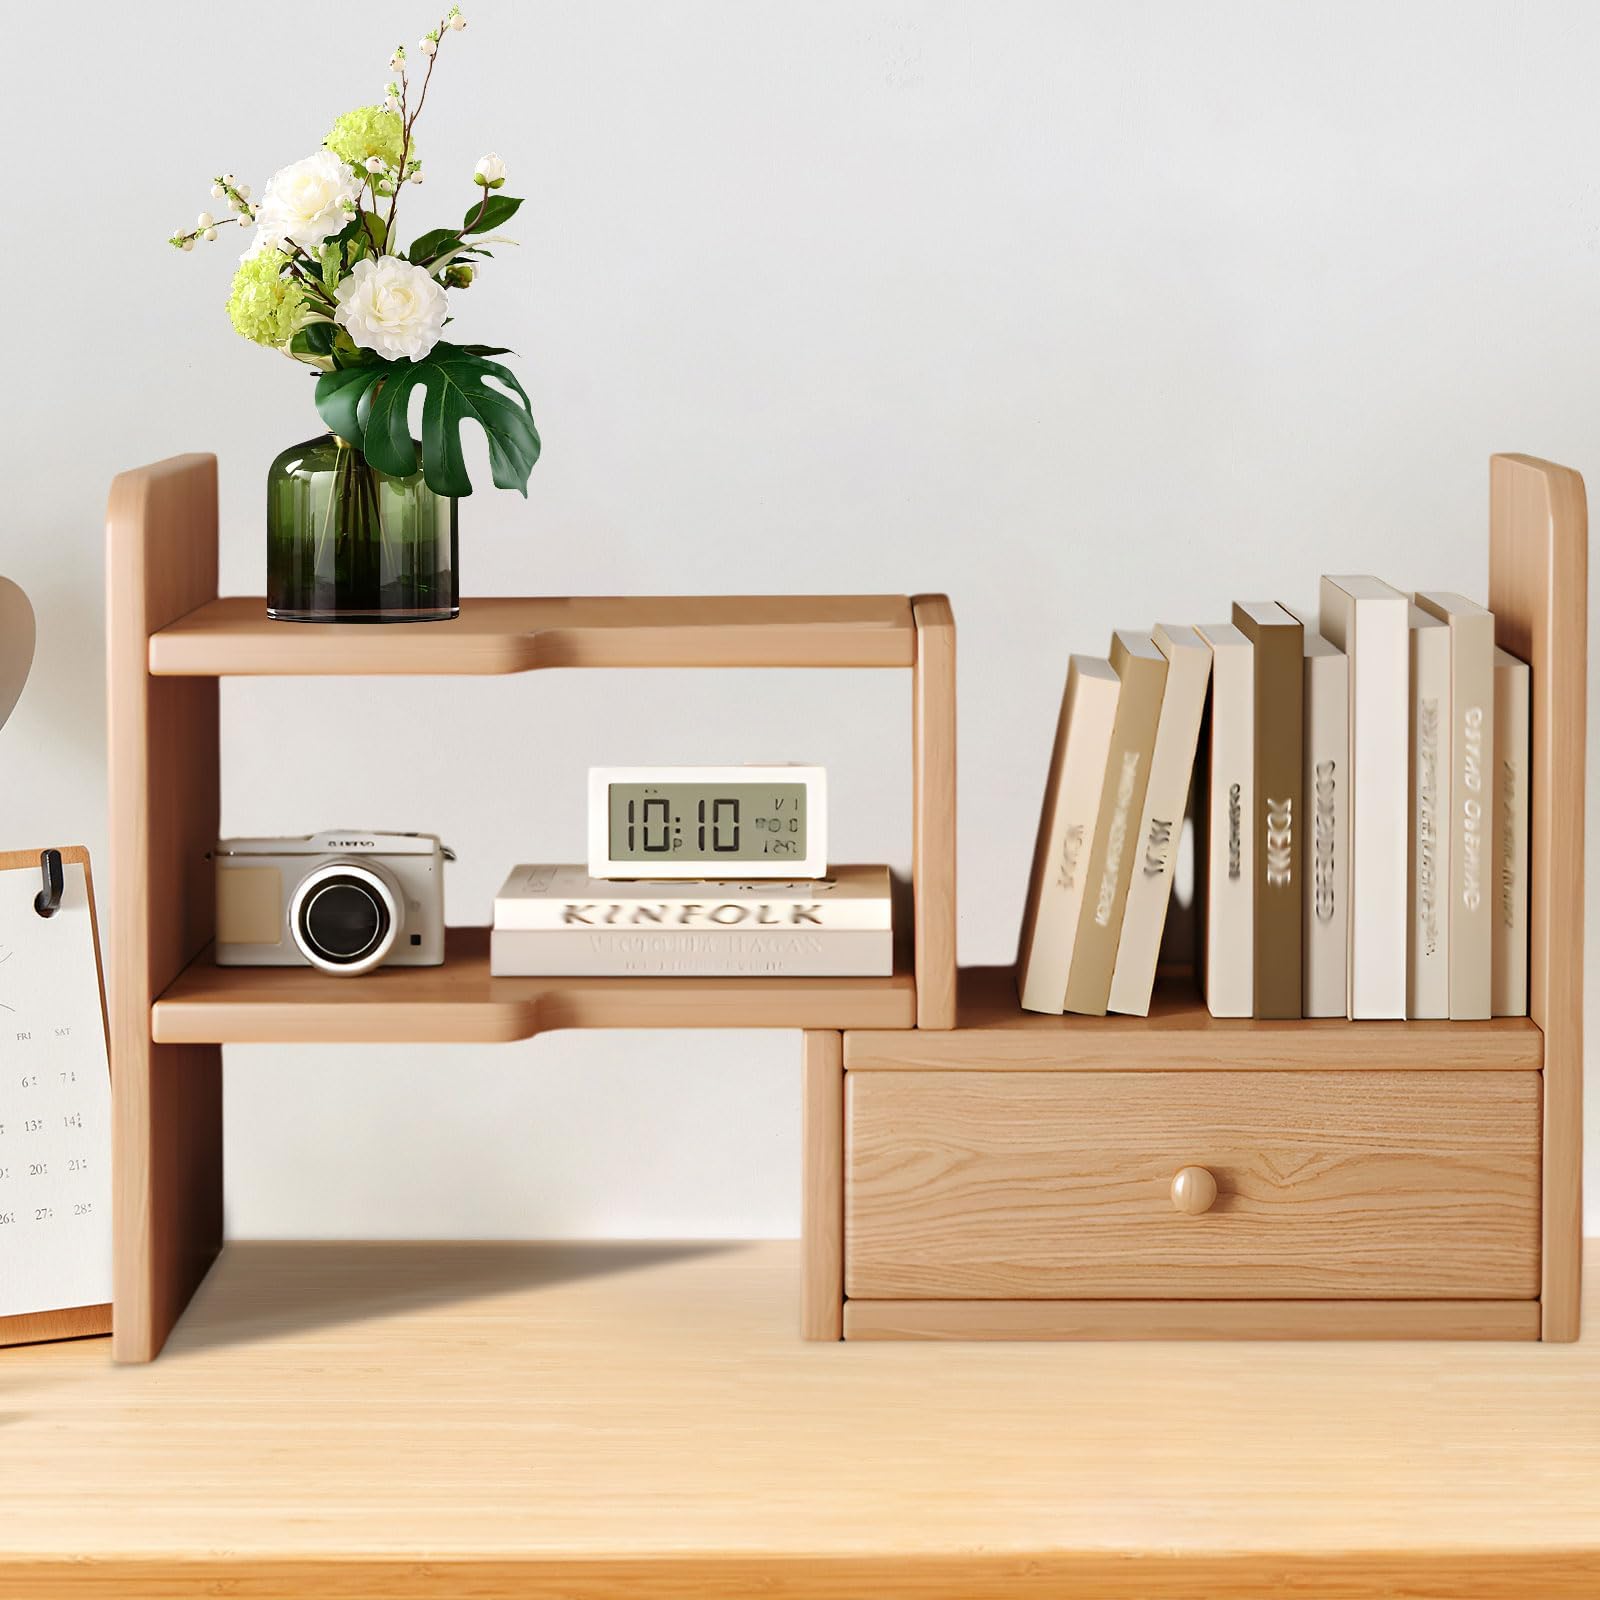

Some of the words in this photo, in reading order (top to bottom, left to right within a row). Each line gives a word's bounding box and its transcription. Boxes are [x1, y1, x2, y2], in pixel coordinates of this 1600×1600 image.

[628, 799, 740, 852] 10:10
[563, 904, 823, 925] KINFOLK
[16, 1032, 32, 1041] FRI
[54, 1027, 71, 1037] SAT
[21, 1076, 29, 1088] 6
[60, 1072, 67, 1083] 7
[25, 1120, 38, 1132] 13
[64, 1116, 76, 1128] 14
[29, 1163, 43, 1176] 20
[68, 1159, 80, 1171] 21
[35, 1208, 48, 1221] 27
[74, 1203, 88, 1216] 28
